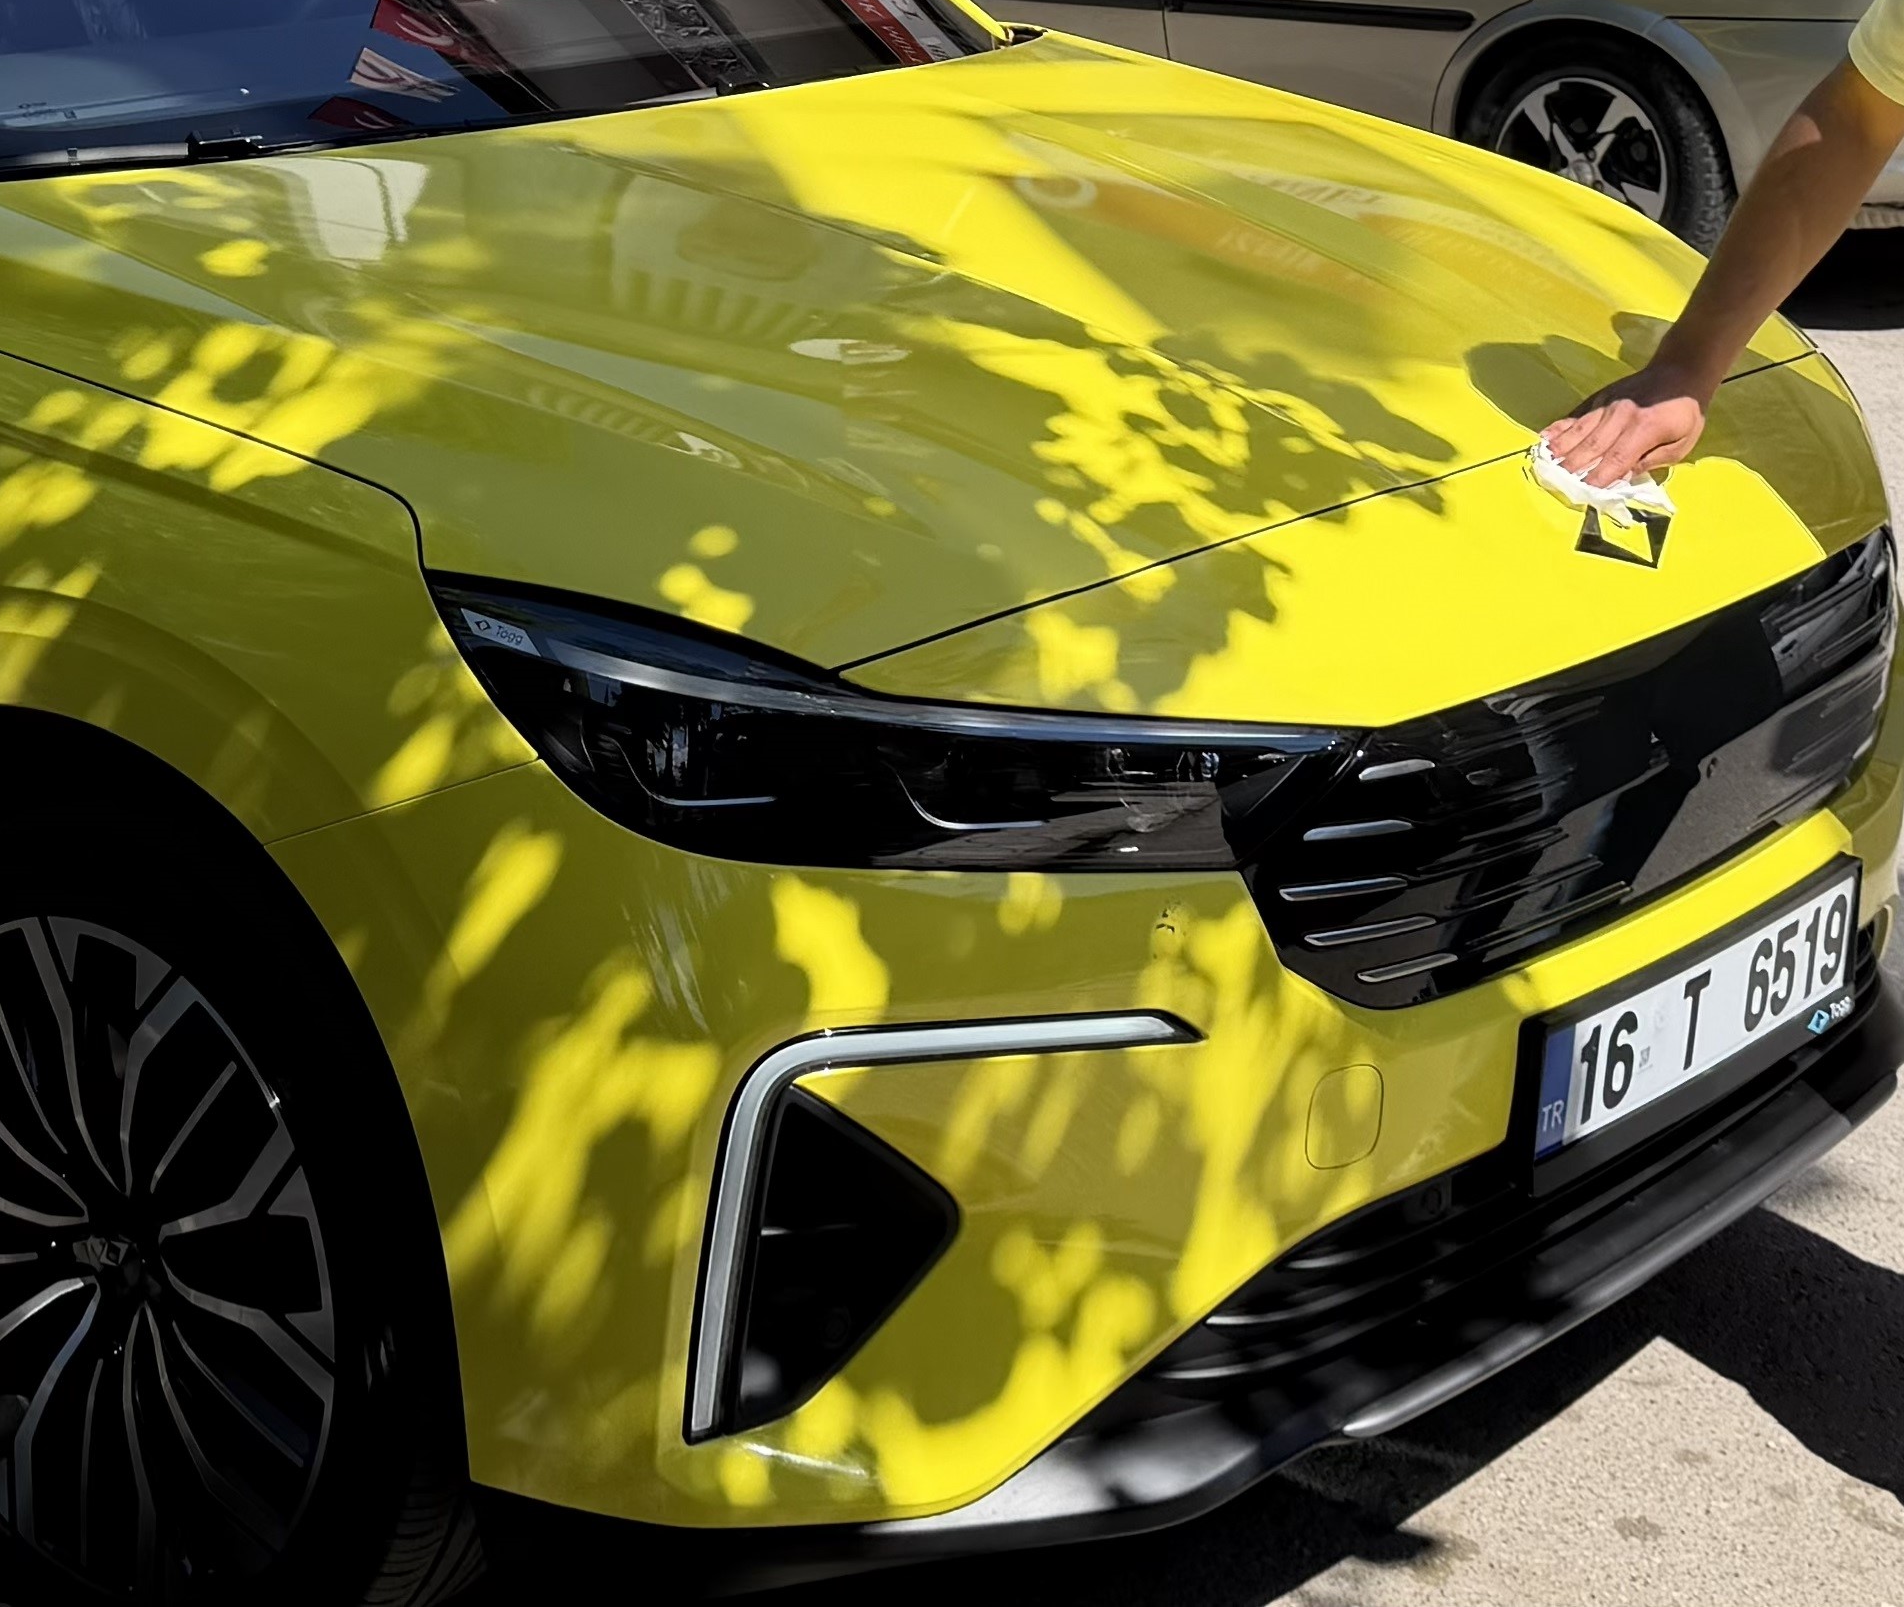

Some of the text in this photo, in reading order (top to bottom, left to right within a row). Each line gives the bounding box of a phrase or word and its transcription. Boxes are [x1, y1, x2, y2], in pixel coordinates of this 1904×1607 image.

[496, 625, 524, 645] Togg
[1580, 894, 1847, 1125] 16 T 6519
[1542, 1100, 1564, 1132] TR
